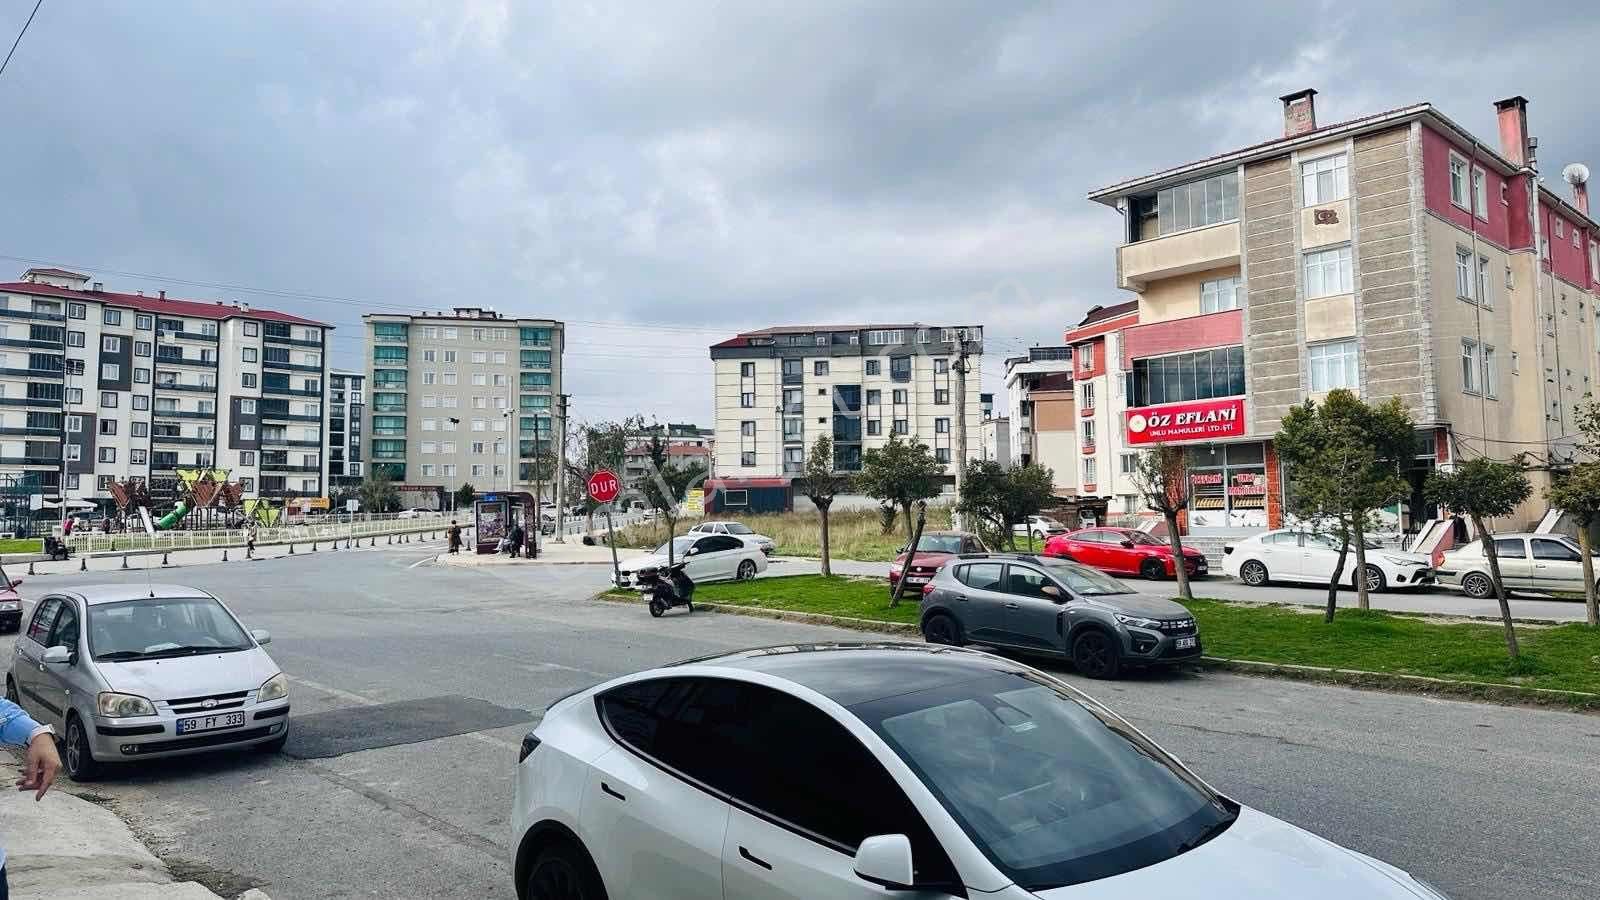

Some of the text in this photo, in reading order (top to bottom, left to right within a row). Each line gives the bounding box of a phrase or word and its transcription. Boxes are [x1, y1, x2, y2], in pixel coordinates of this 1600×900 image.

[1148, 405, 1238, 428] ÖZ EFLANİ
[590, 479, 617, 495] DUR
[184, 713, 243, 731] 59 FY 333
